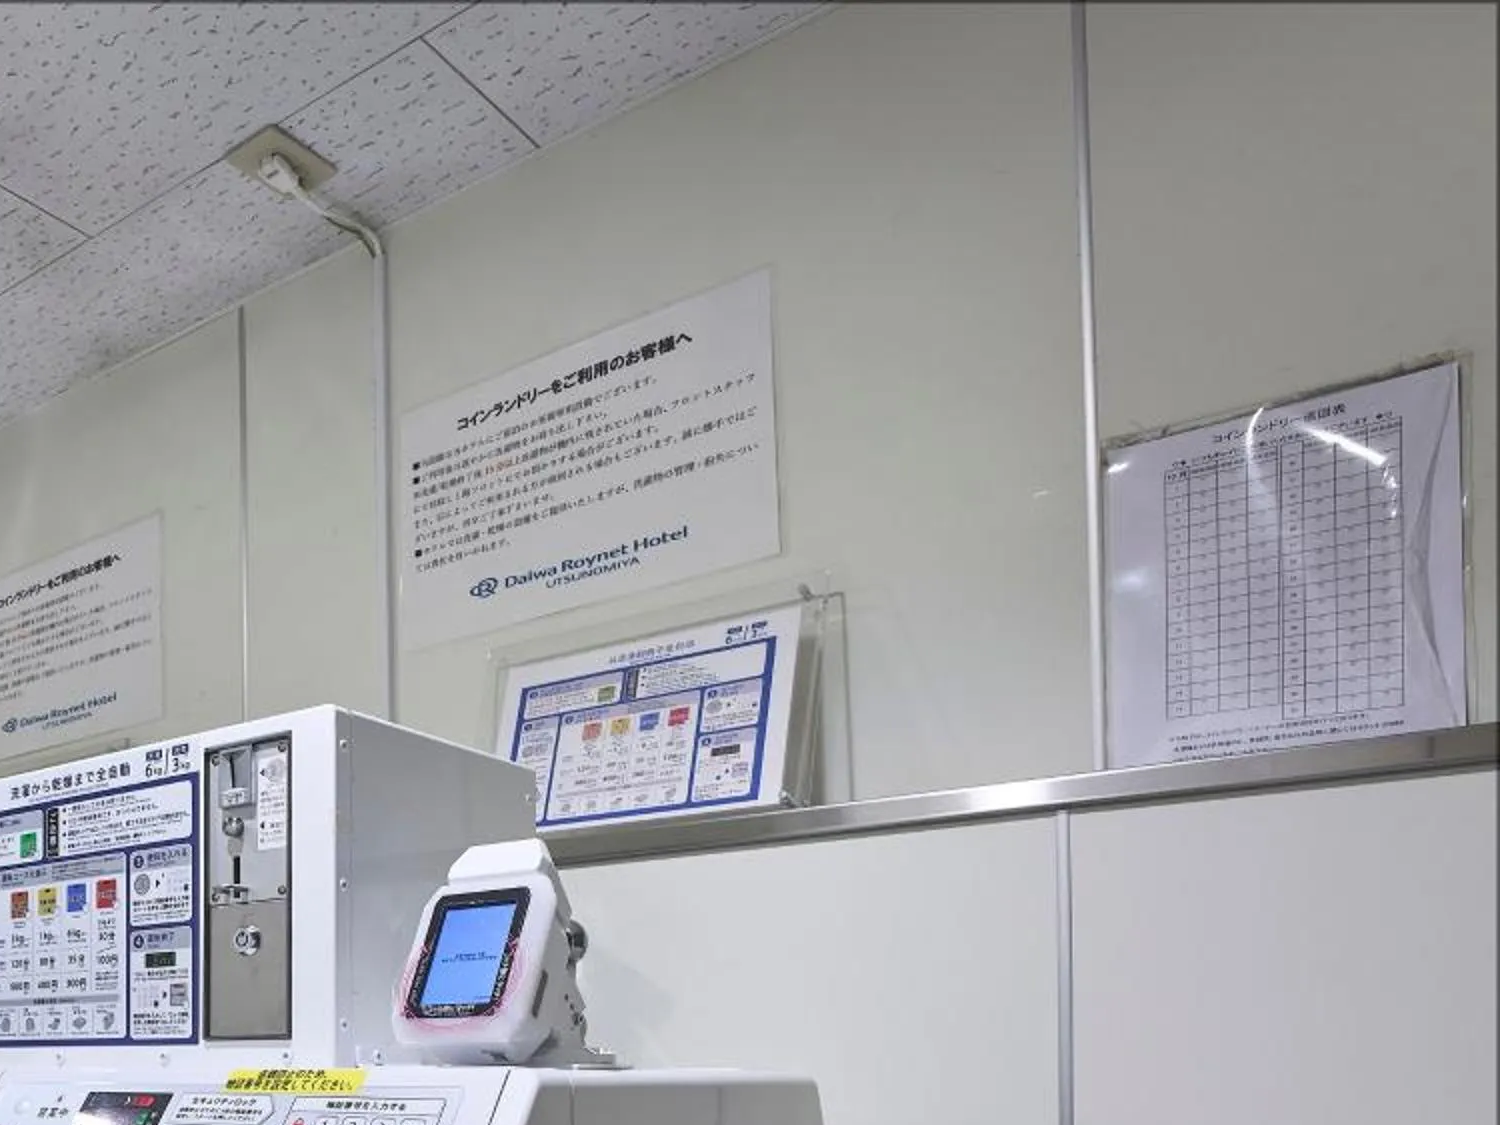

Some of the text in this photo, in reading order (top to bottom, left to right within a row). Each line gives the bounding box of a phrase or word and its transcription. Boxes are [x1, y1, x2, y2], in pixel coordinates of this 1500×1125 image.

[456, 332, 693, 431] コインランドリーをご利用のお客様へ
[504, 525, 689, 589] Daiwa Roynet Hotel
[545, 557, 641, 589] UTSUNOMIYA
